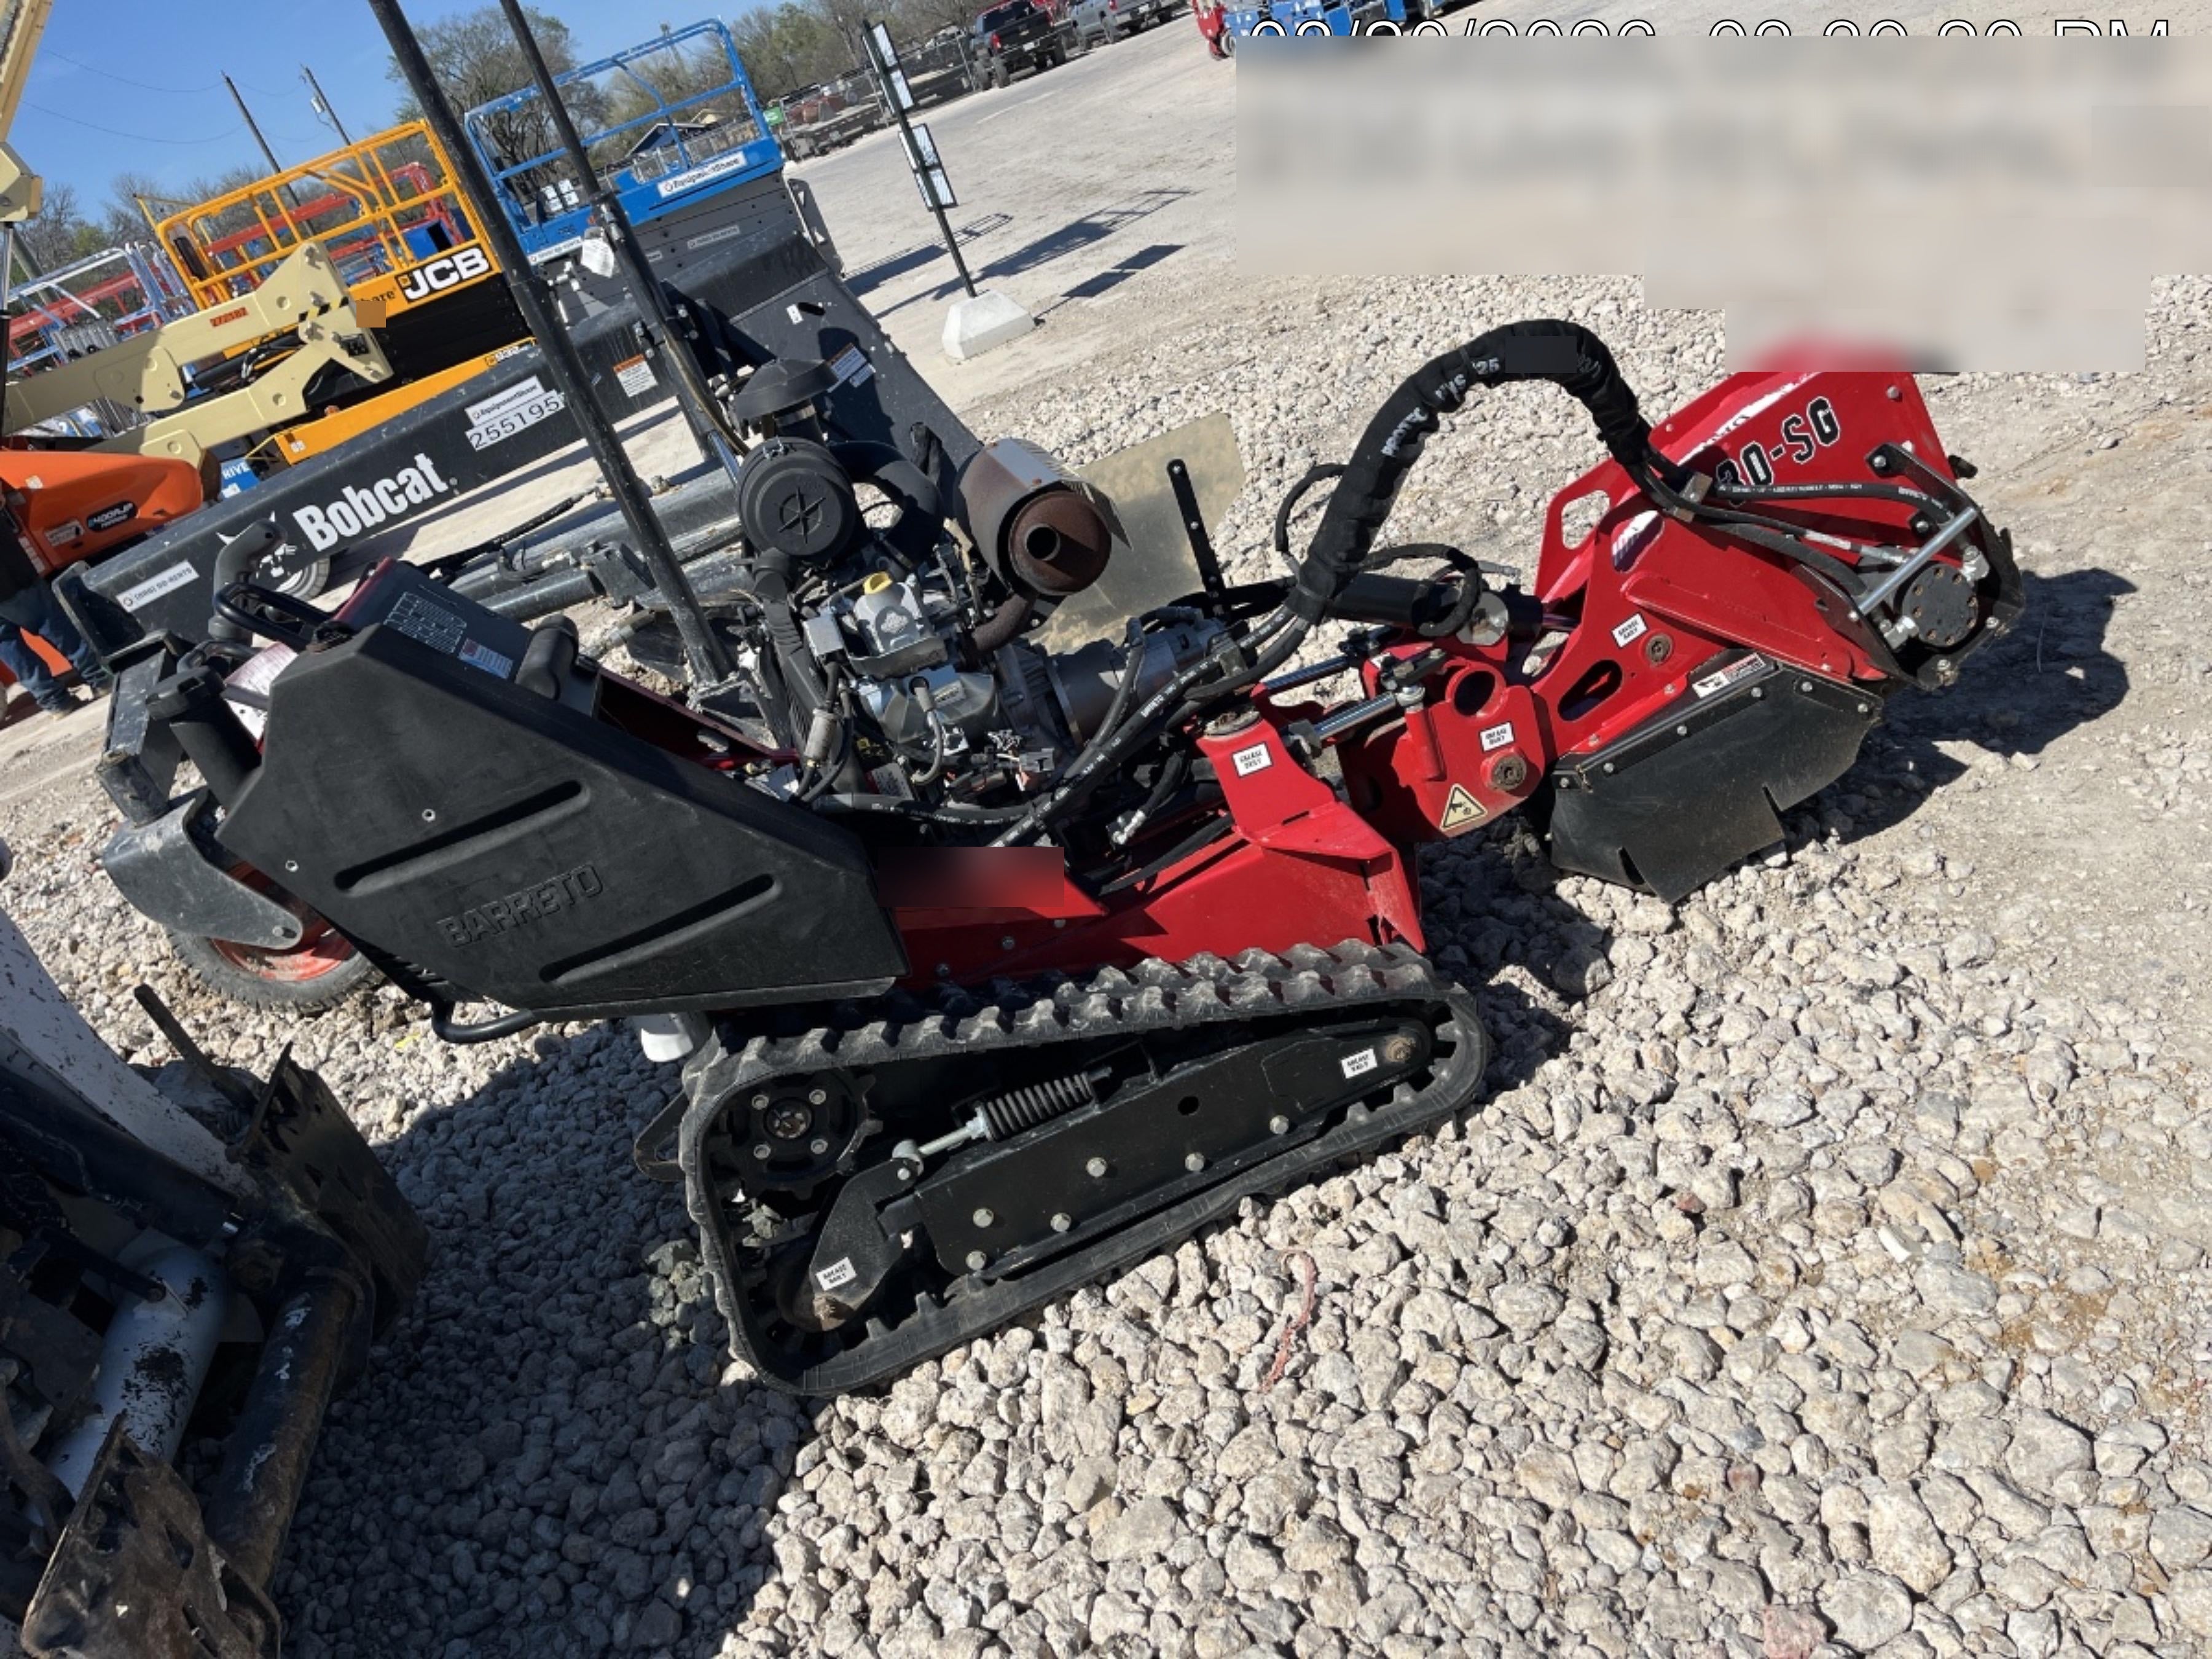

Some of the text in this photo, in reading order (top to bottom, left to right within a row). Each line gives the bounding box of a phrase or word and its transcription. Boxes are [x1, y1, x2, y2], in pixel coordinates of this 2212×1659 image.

[404, 248, 489, 300] JCB
[469, 395, 560, 449] 255195
[292, 453, 449, 552] Bobcat
[436, 862, 603, 947] BARRETO
